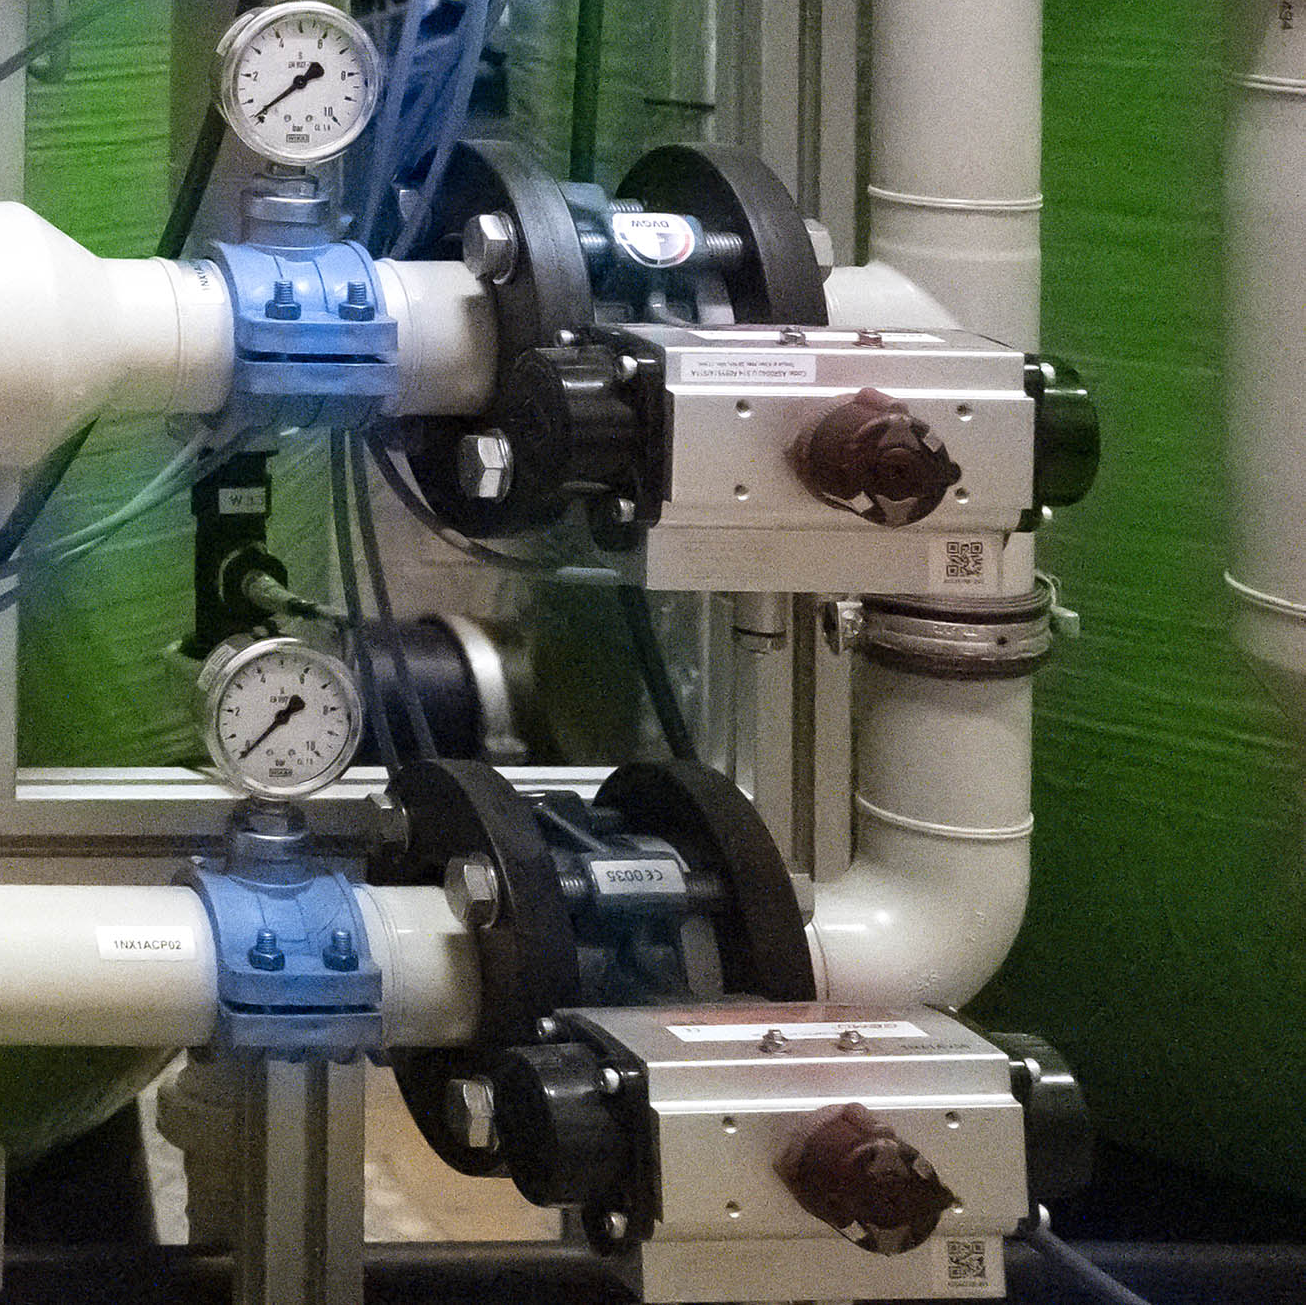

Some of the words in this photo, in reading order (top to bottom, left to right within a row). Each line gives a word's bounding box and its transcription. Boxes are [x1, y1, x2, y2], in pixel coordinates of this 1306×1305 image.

[278, 38, 285, 49] 4
[253, 71, 259, 82] 2
[324, 107, 333, 117] 10
[292, 124, 304, 132] bar
[631, 219, 670, 228] DVGW
[305, 740, 316, 752] 10
[113, 939, 182, 950] 1NX1ACP02
